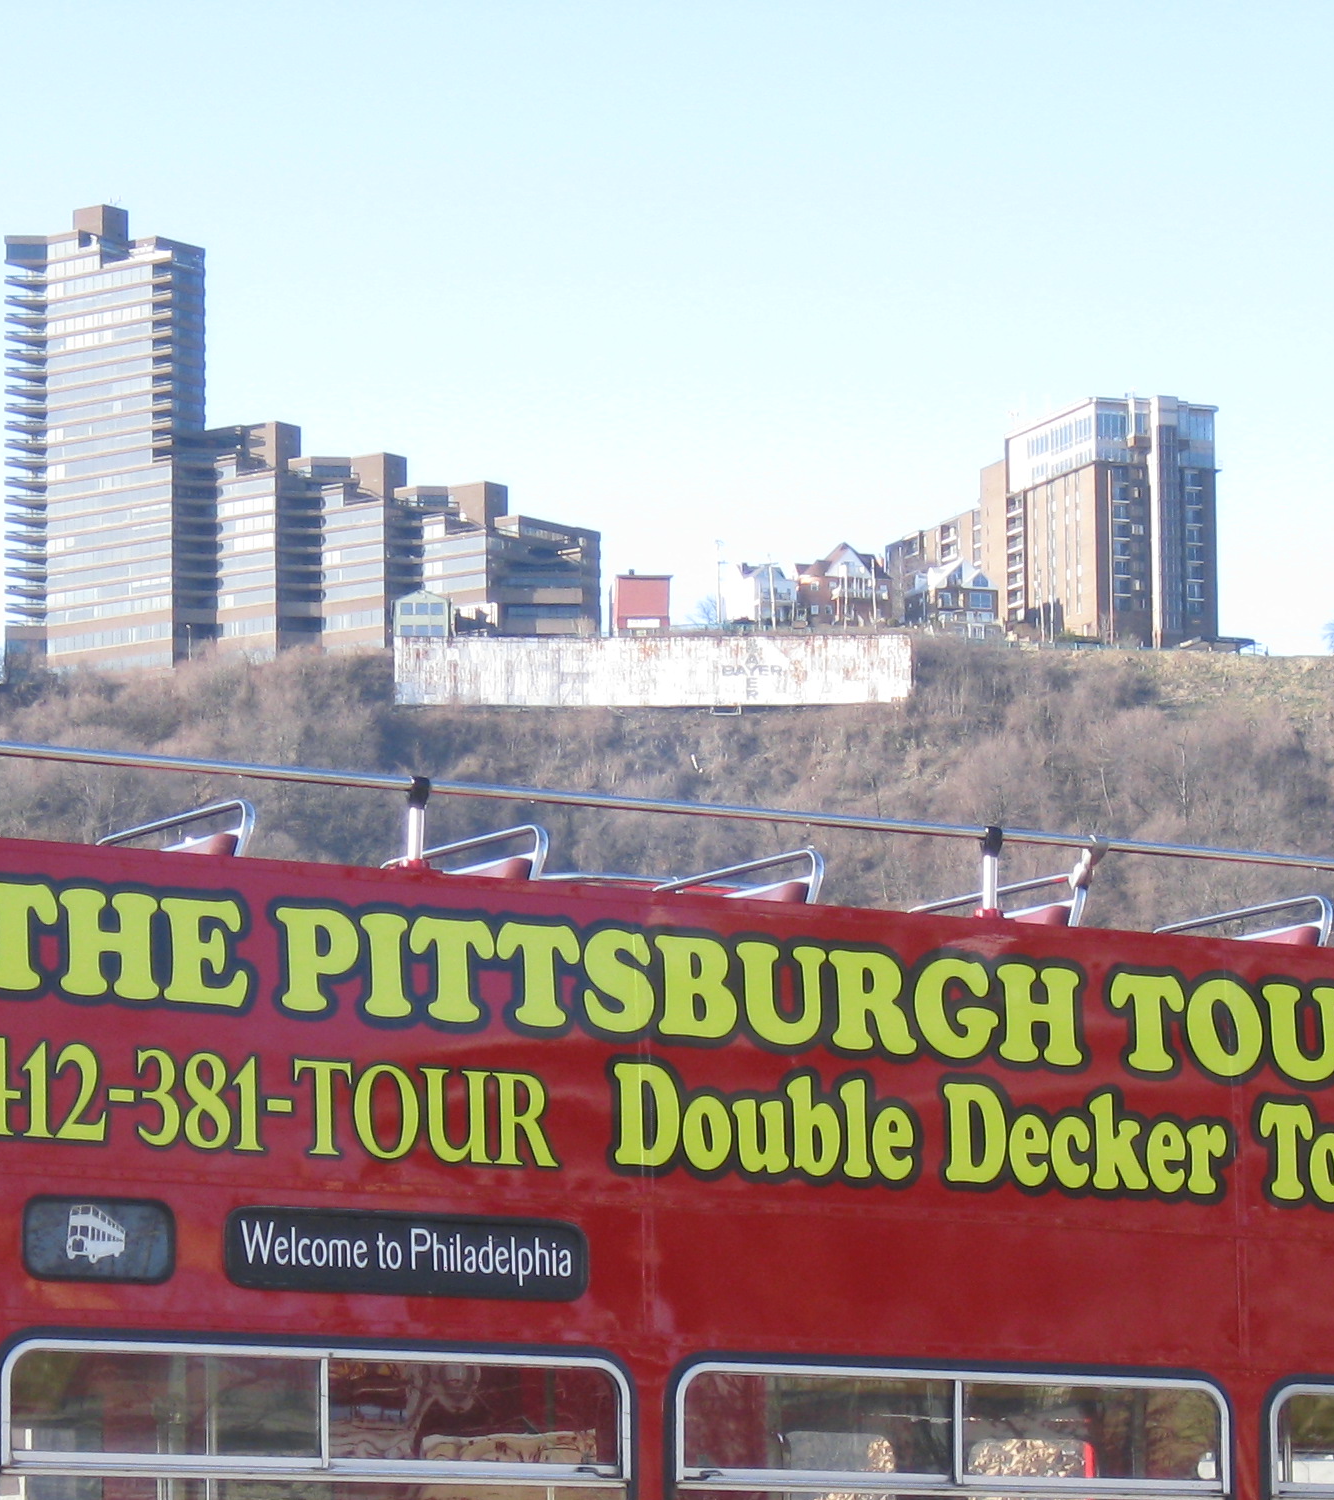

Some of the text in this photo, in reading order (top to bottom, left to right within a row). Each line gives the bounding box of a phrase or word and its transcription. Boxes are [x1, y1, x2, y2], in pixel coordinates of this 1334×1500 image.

[721, 664, 783, 677] BAYER
[276, 907, 1083, 1067] PITTSBURGH
[614, 1063, 914, 1181] Double
[944, 1082, 1227, 1195] Decker
[239, 1220, 573, 1286] Welcome to Philadelphia
